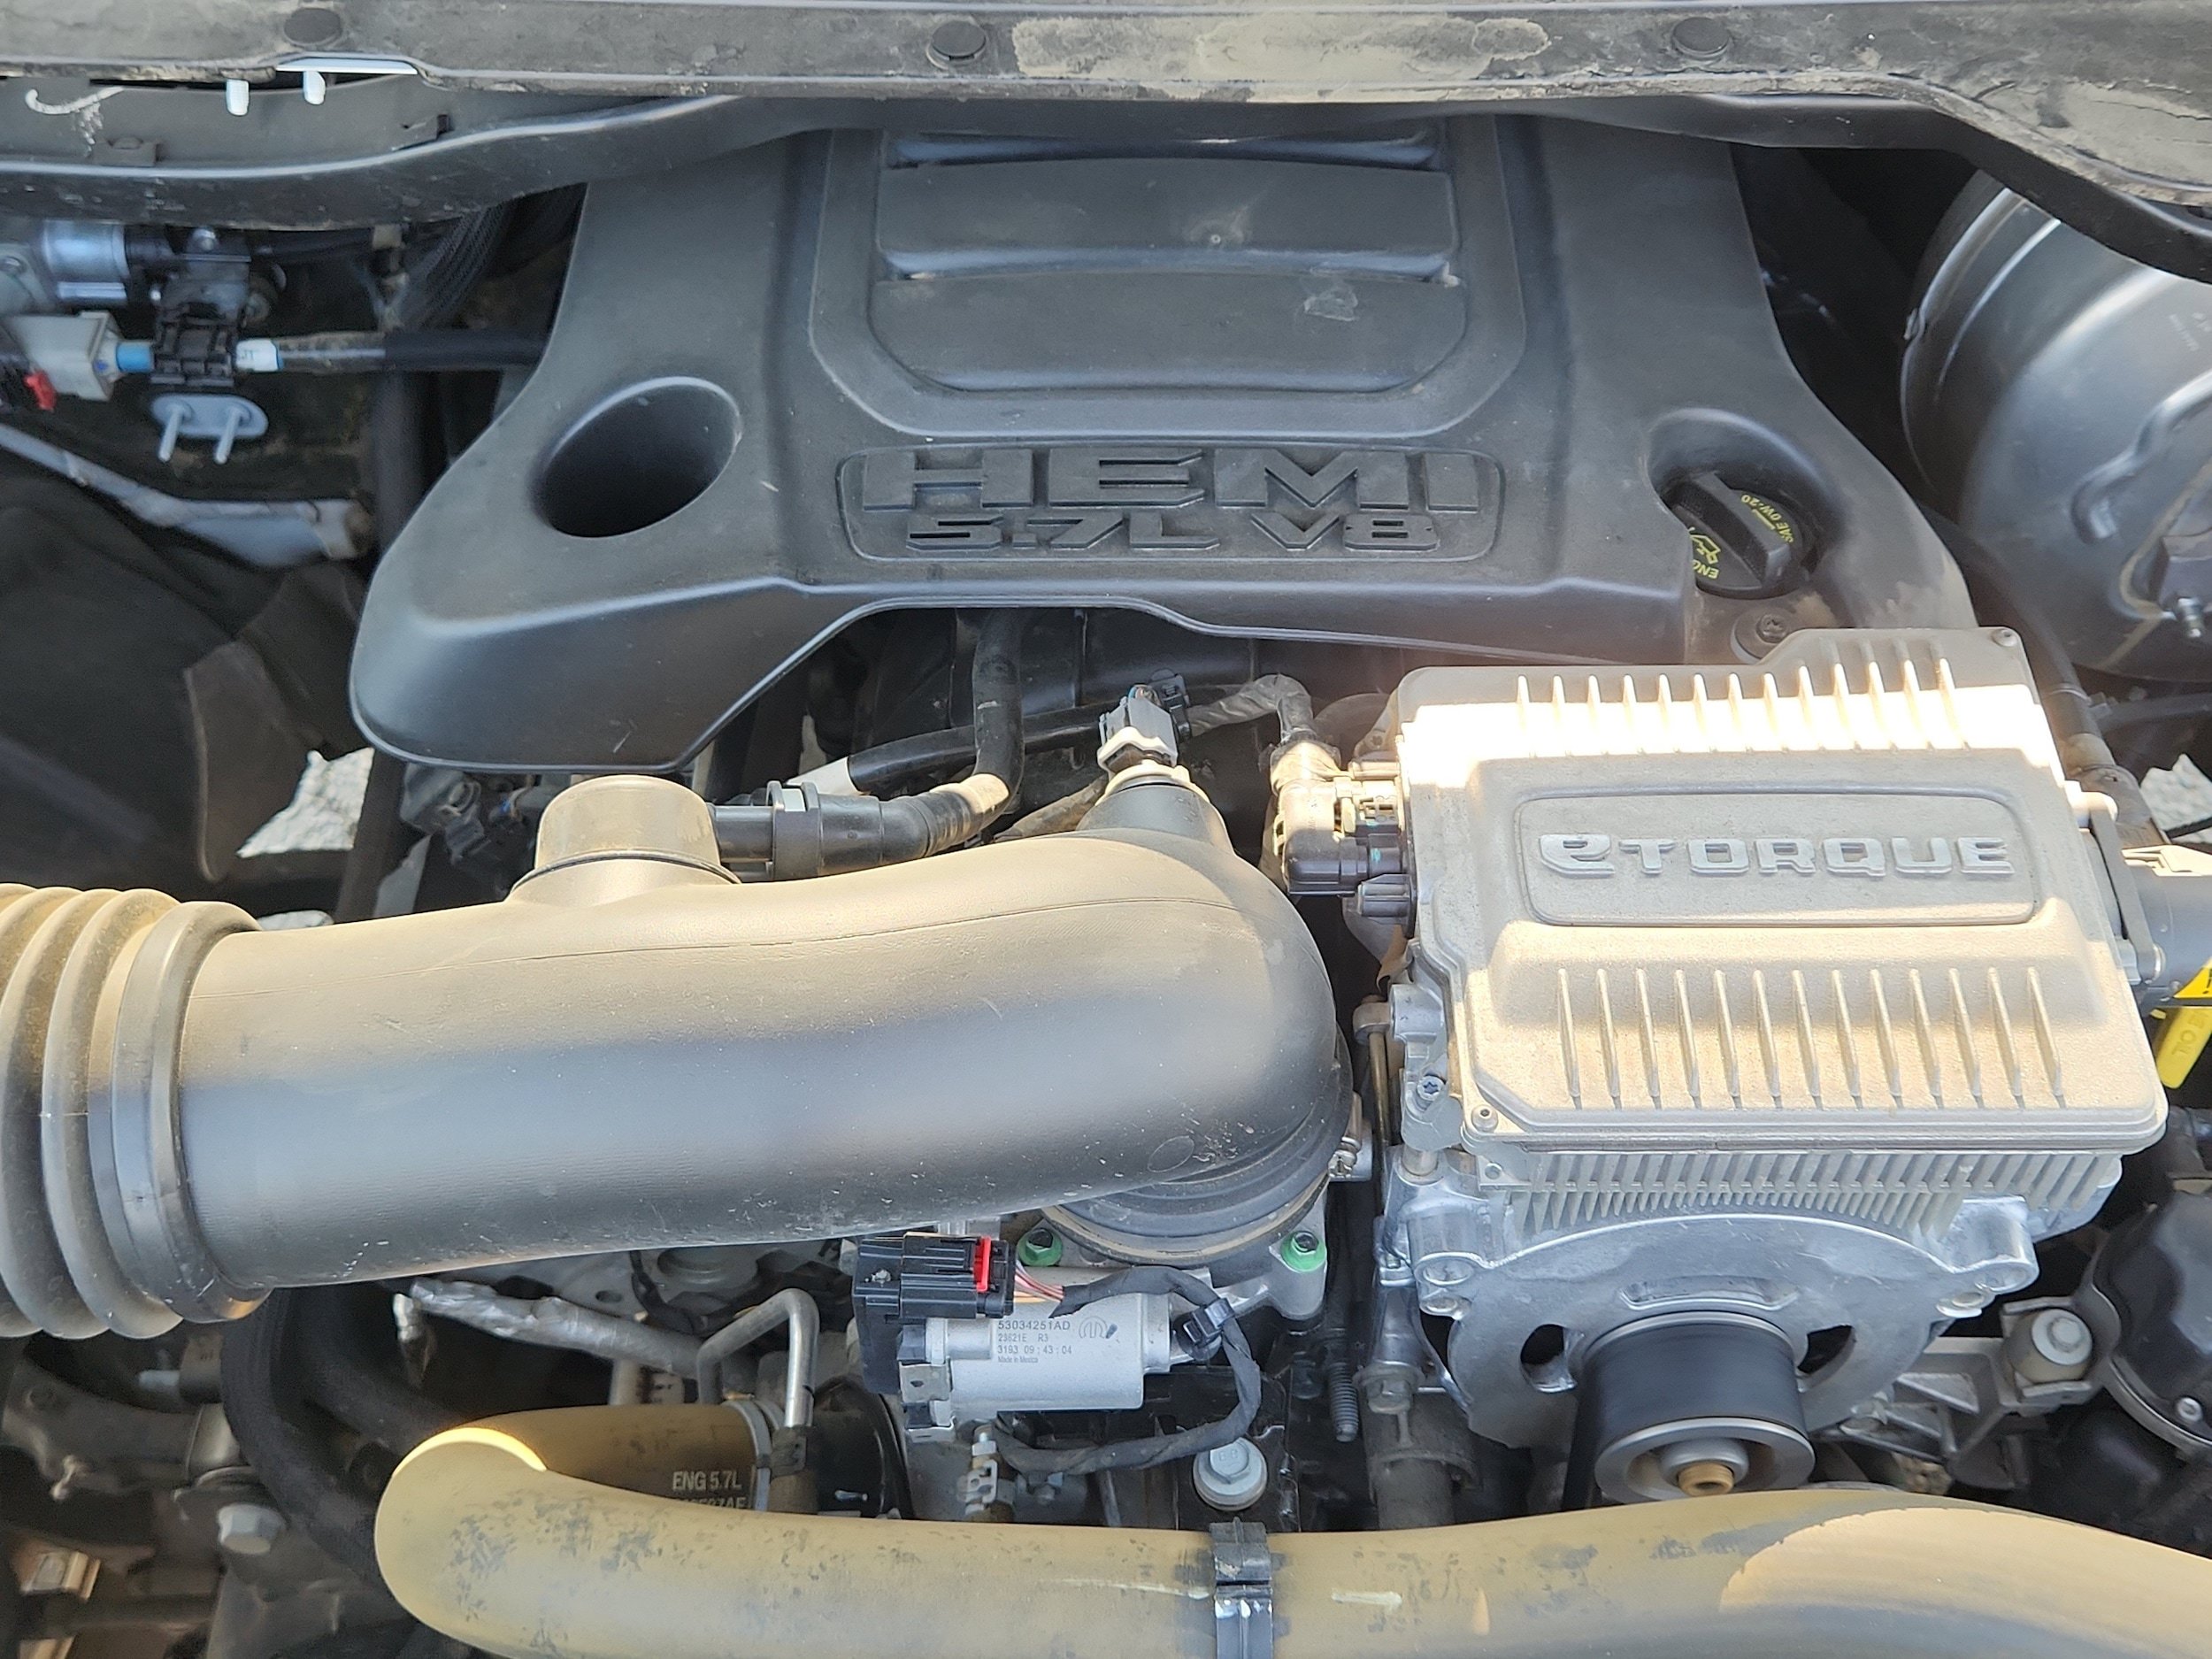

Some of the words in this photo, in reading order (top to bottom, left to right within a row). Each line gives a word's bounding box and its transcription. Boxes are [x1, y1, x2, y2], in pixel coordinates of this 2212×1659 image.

[863, 448, 1479, 511] HEMI
[906, 513, 1221, 551] 5.7L
[1250, 511, 1441, 552] V8
[1539, 833, 2015, 877] eTORQUE
[998, 1319, 1071, 1331] 53034251AD
[672, 1471, 706, 1491] ENG
[710, 1471, 742, 1489] 5.7L
